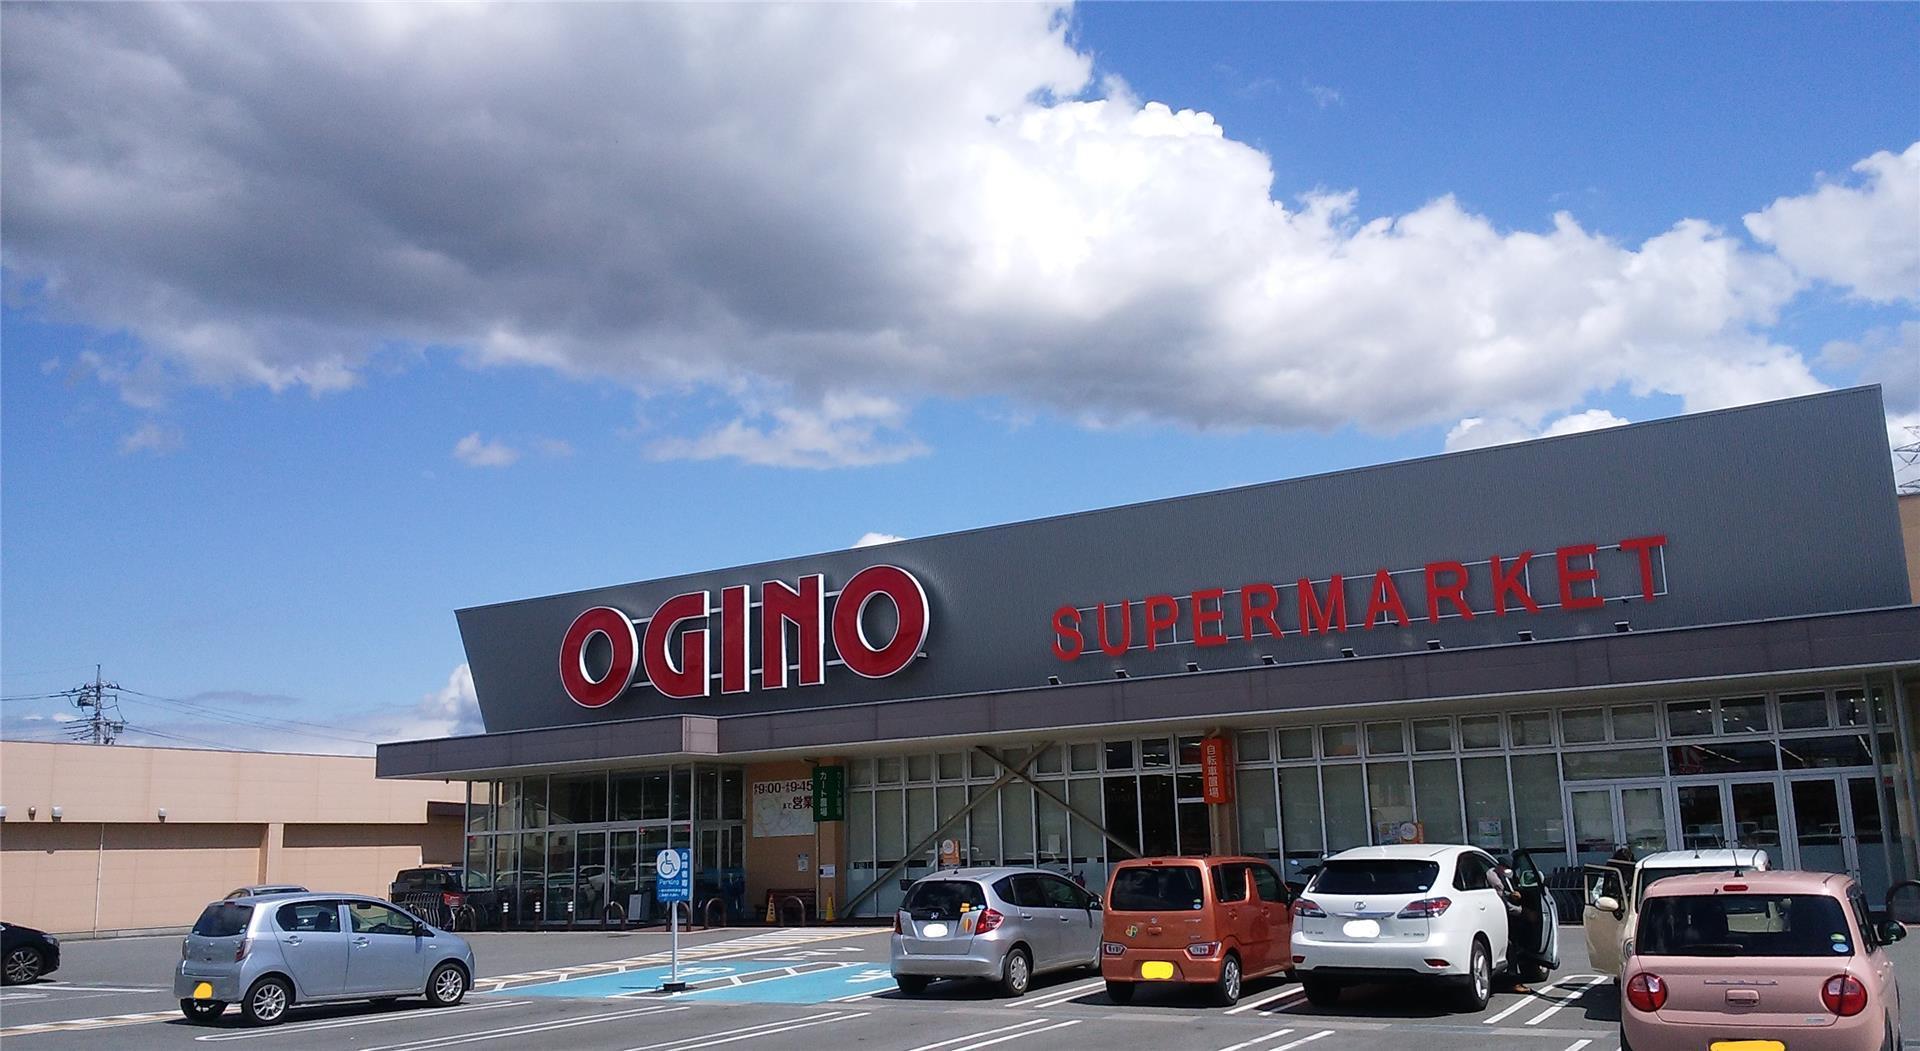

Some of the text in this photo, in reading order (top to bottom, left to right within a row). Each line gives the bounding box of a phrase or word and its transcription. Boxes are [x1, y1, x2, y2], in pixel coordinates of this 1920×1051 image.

[559, 564, 930, 709] OGINO
[1052, 535, 1668, 661] SUPERMARKET
[1207, 745, 1218, 797] 自転車置場
